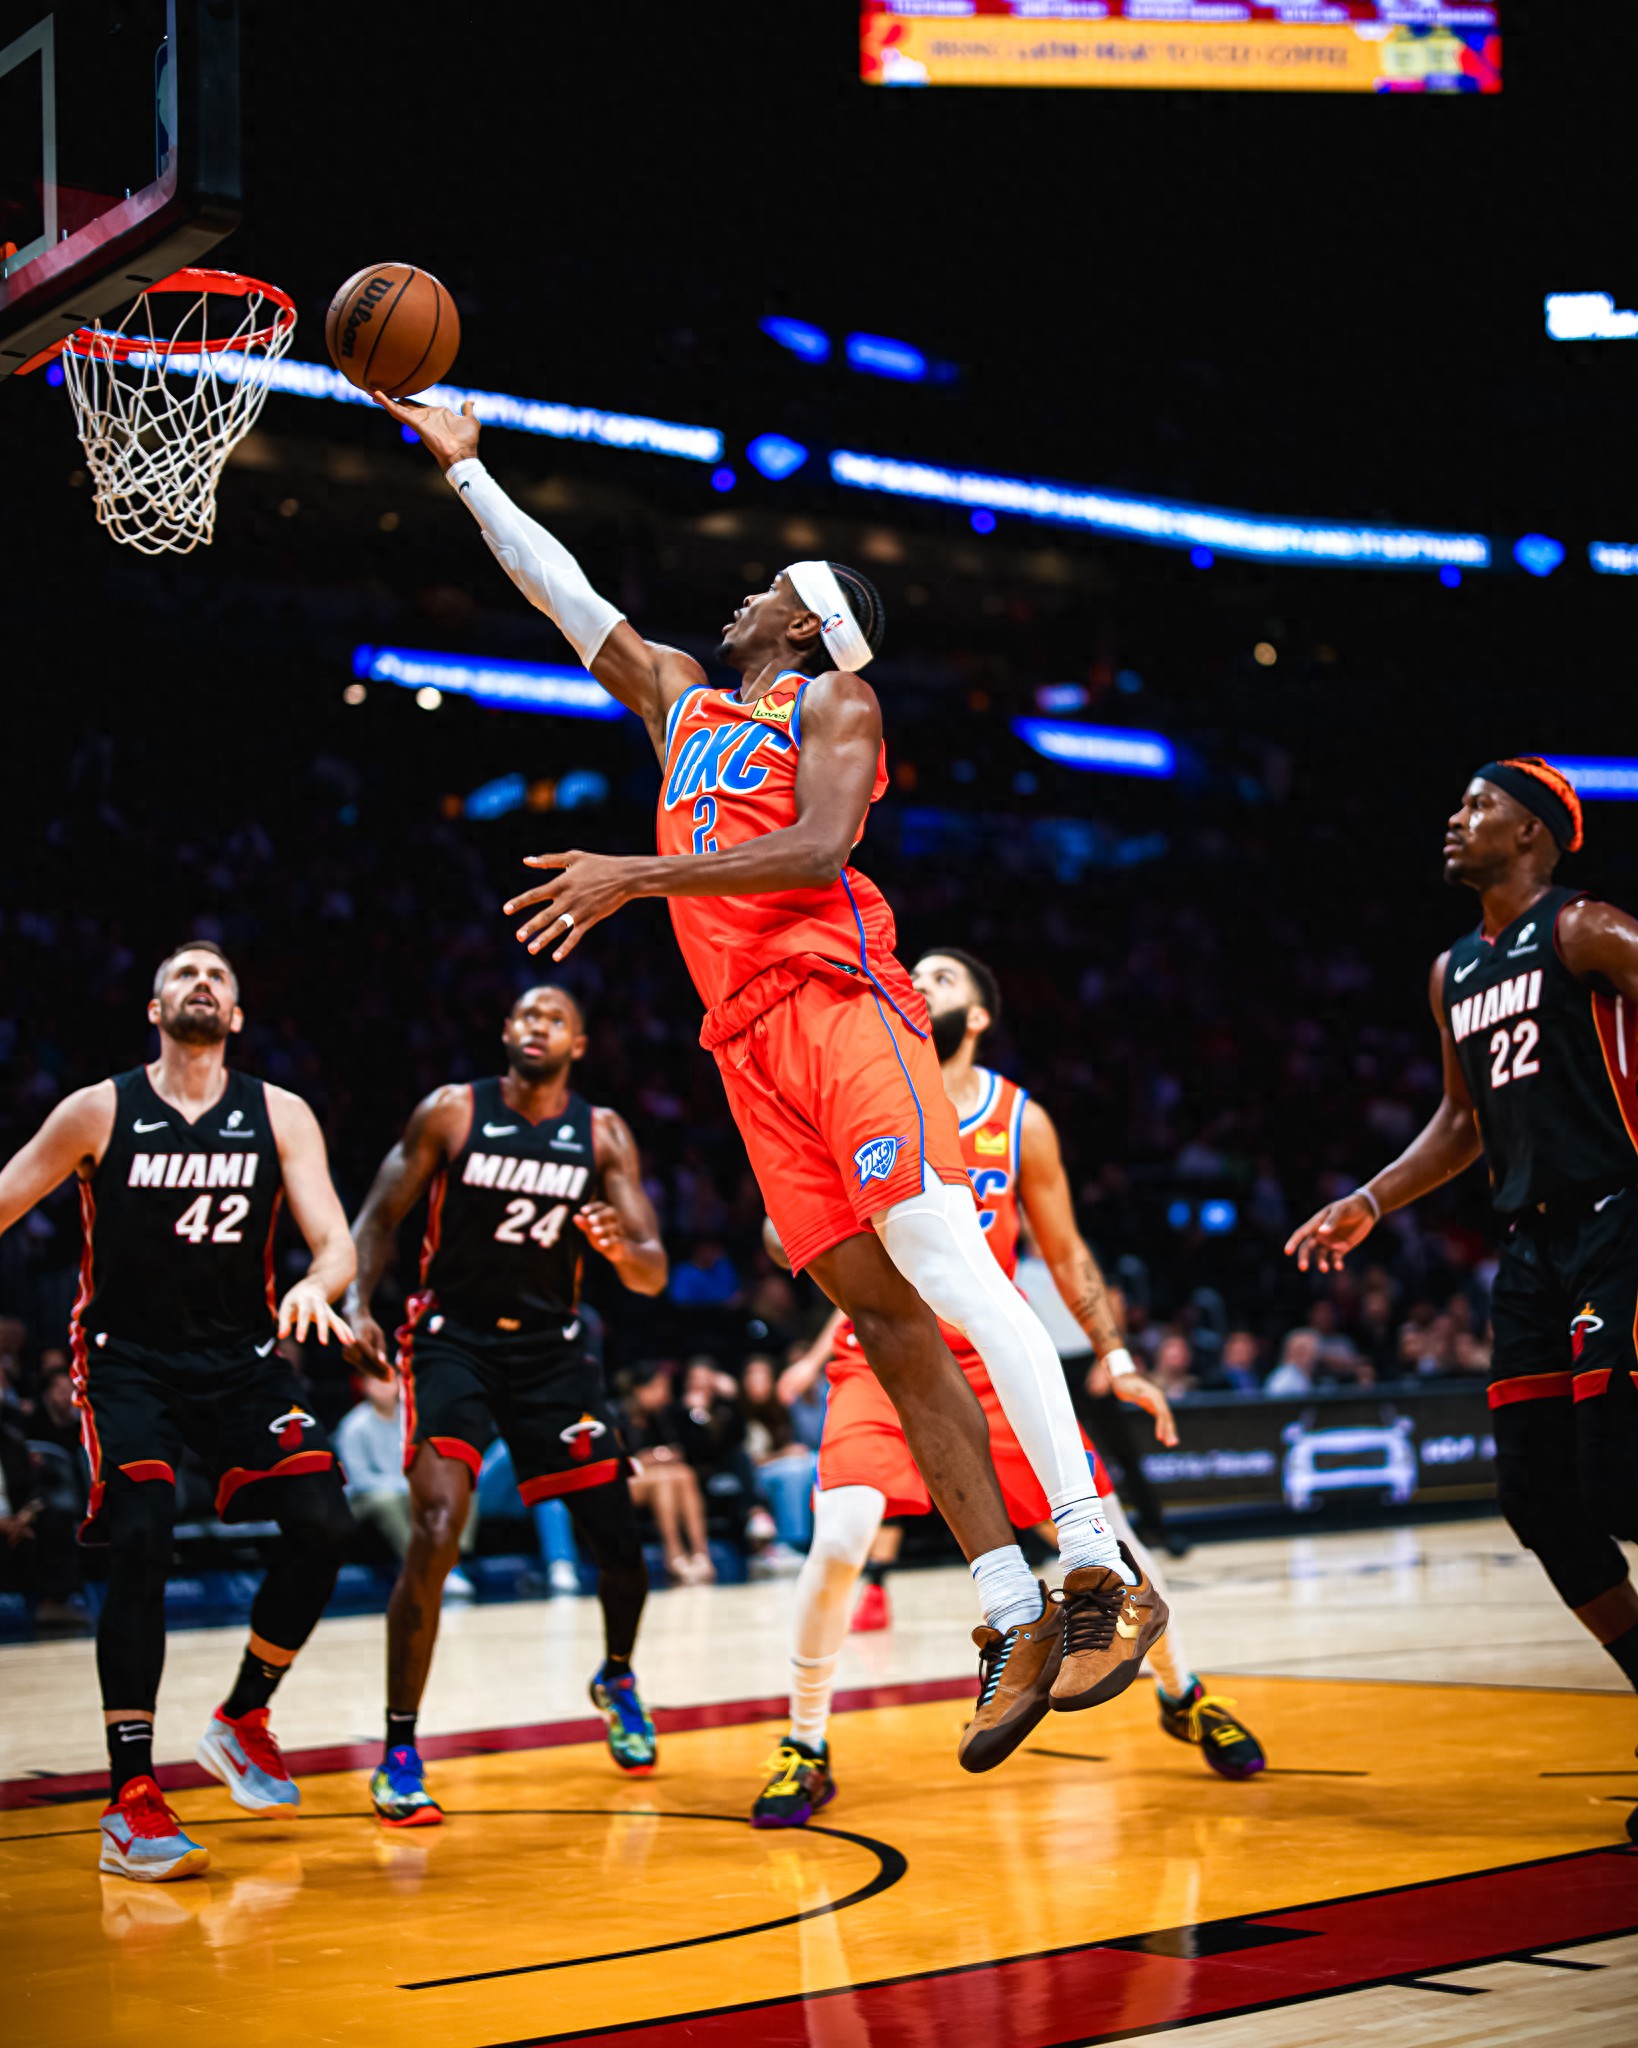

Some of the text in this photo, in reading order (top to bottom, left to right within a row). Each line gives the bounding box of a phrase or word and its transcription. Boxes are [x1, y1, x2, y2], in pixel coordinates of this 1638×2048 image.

[341, 277, 395, 358] Wilson
[664, 720, 793, 811] OKC
[692, 795, 718, 855] 2
[1451, 968, 1543, 1044] MIAMI
[1489, 1018, 1540, 1089] 22
[127, 1152, 259, 1188] MIAMI
[462, 1152, 589, 1200] MIAMI
[860, 1141, 888, 1181] OKC
[174, 1194, 250, 1243] 42
[494, 1198, 568, 1248] 24
